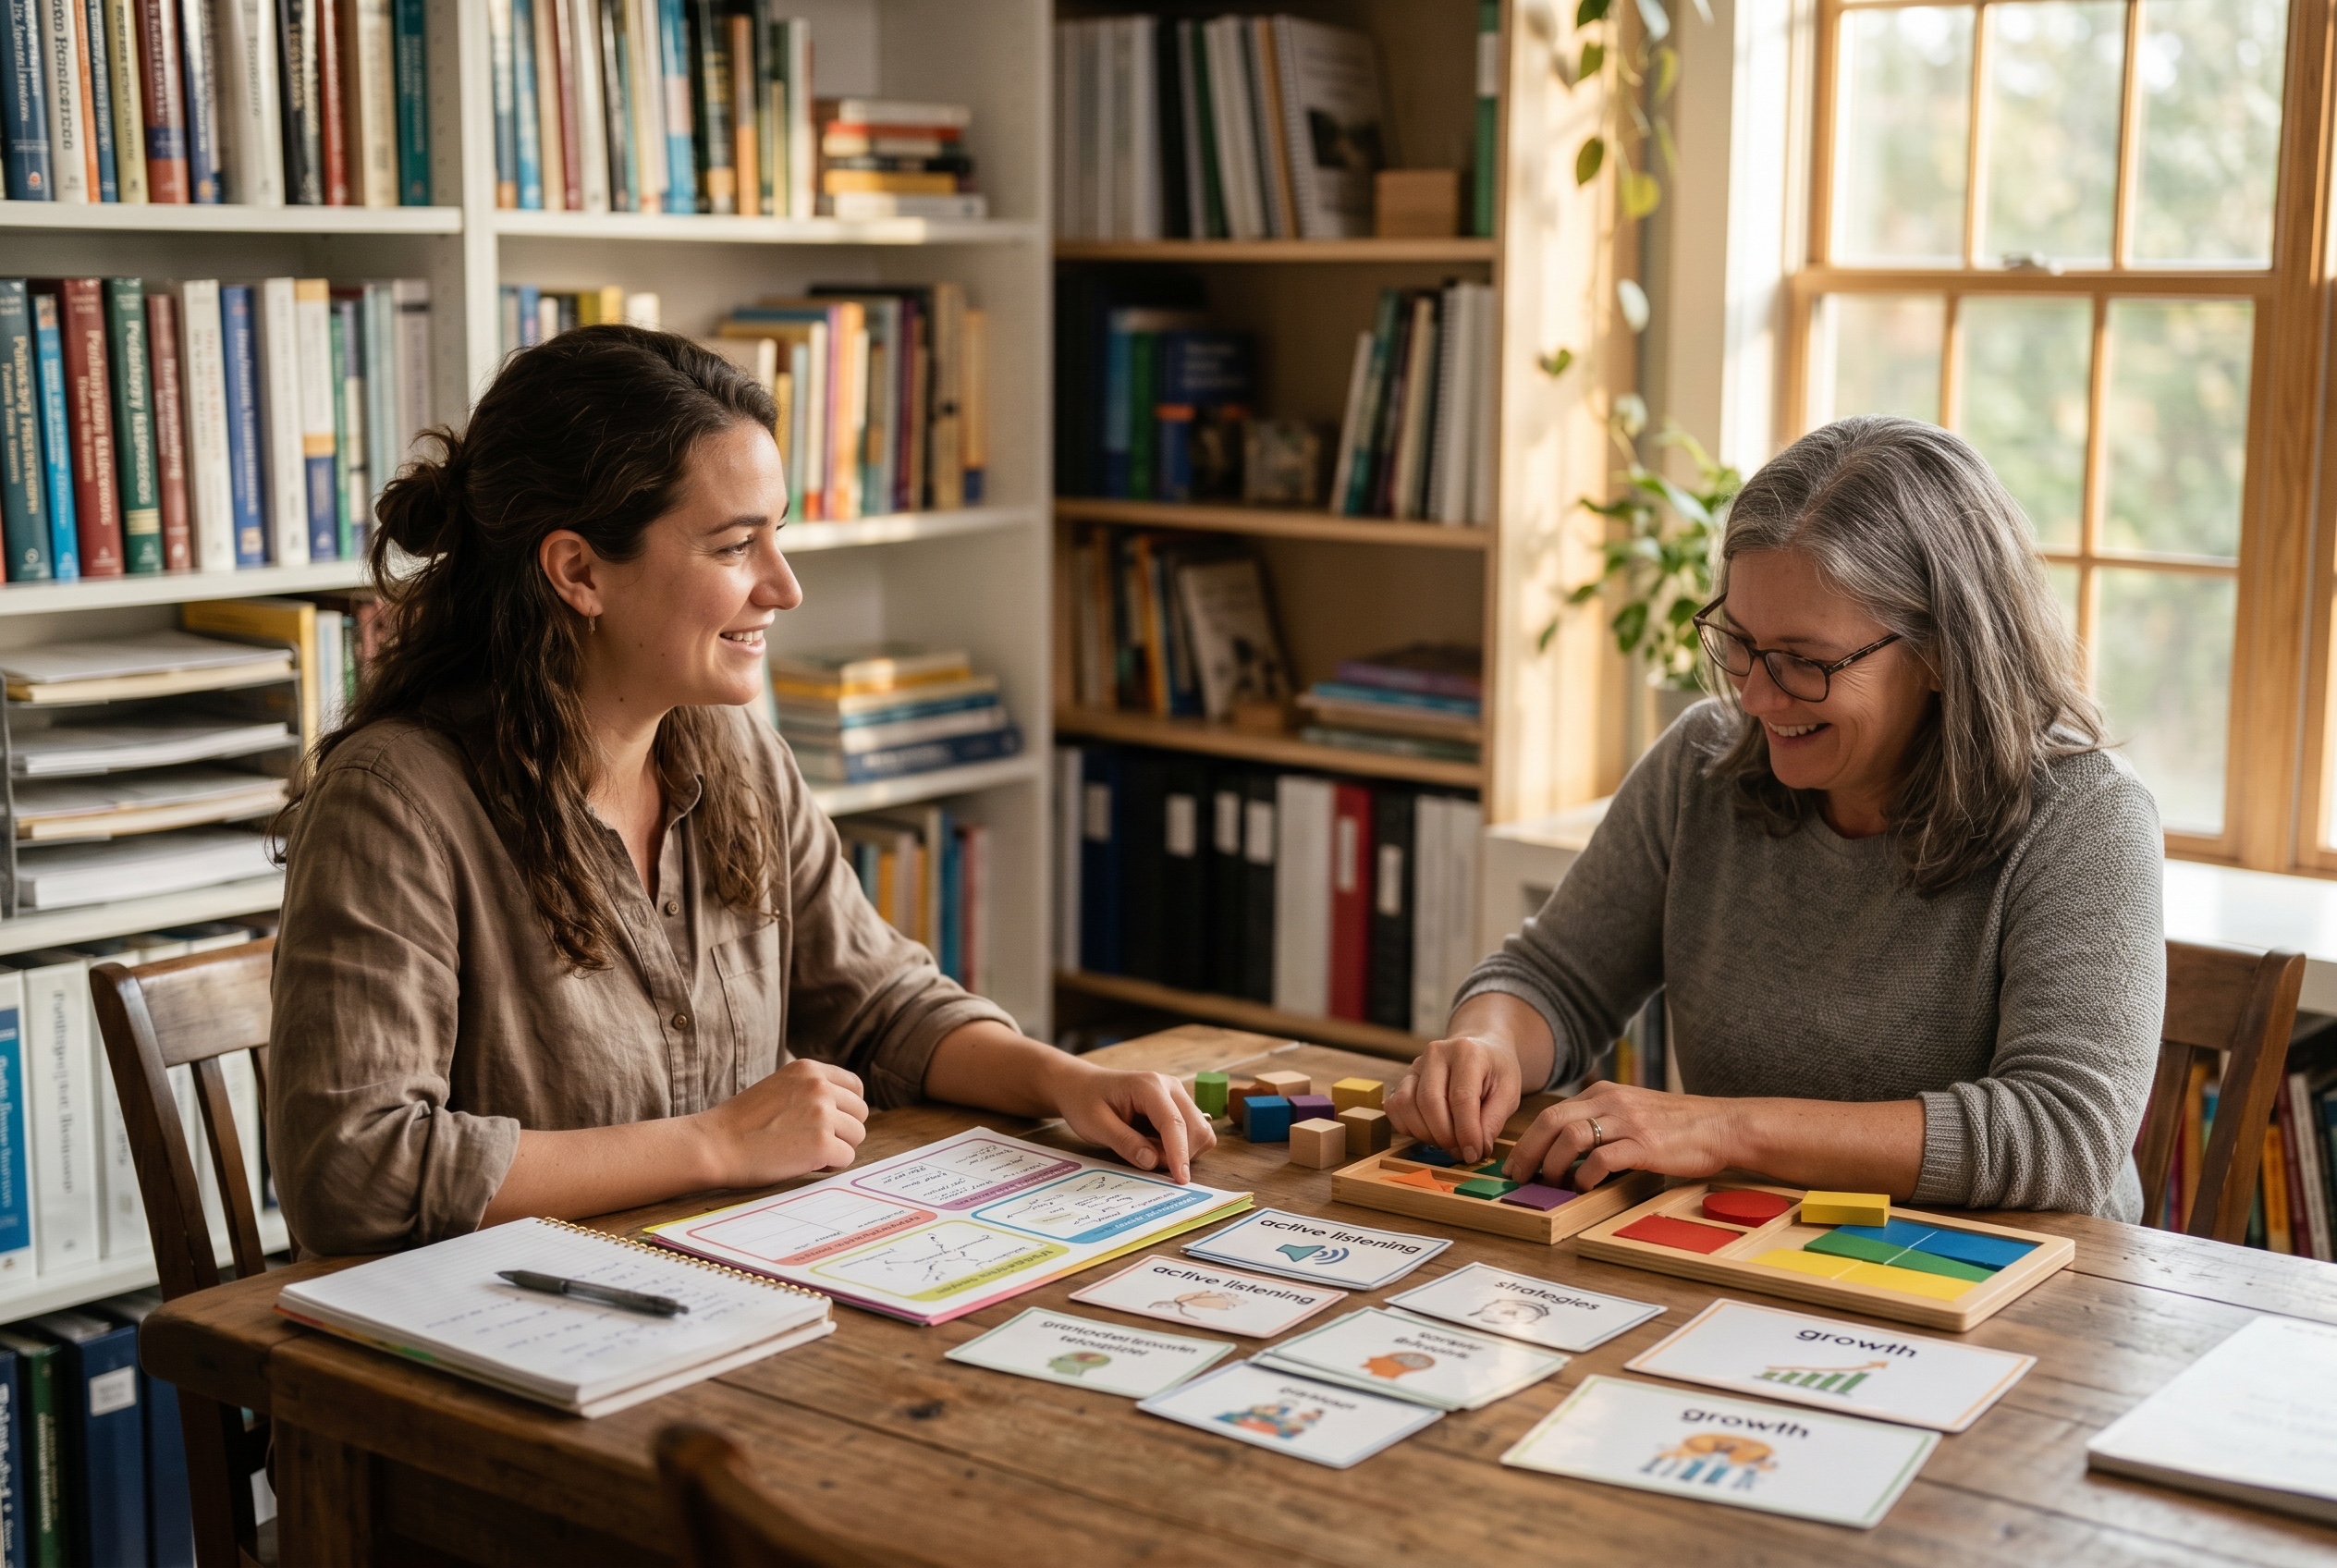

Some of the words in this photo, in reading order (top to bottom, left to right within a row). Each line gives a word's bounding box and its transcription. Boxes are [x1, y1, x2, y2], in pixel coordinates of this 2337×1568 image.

[1260, 1218, 1327, 1236] active
[1329, 1231, 1422, 1255] listening
[1153, 1265, 1219, 1284] active
[1223, 1280, 1316, 1305] listening
[1495, 1279, 1601, 1312] strategies
[1795, 1329, 1917, 1358] growth
[1681, 1408, 1810, 1439] growth
